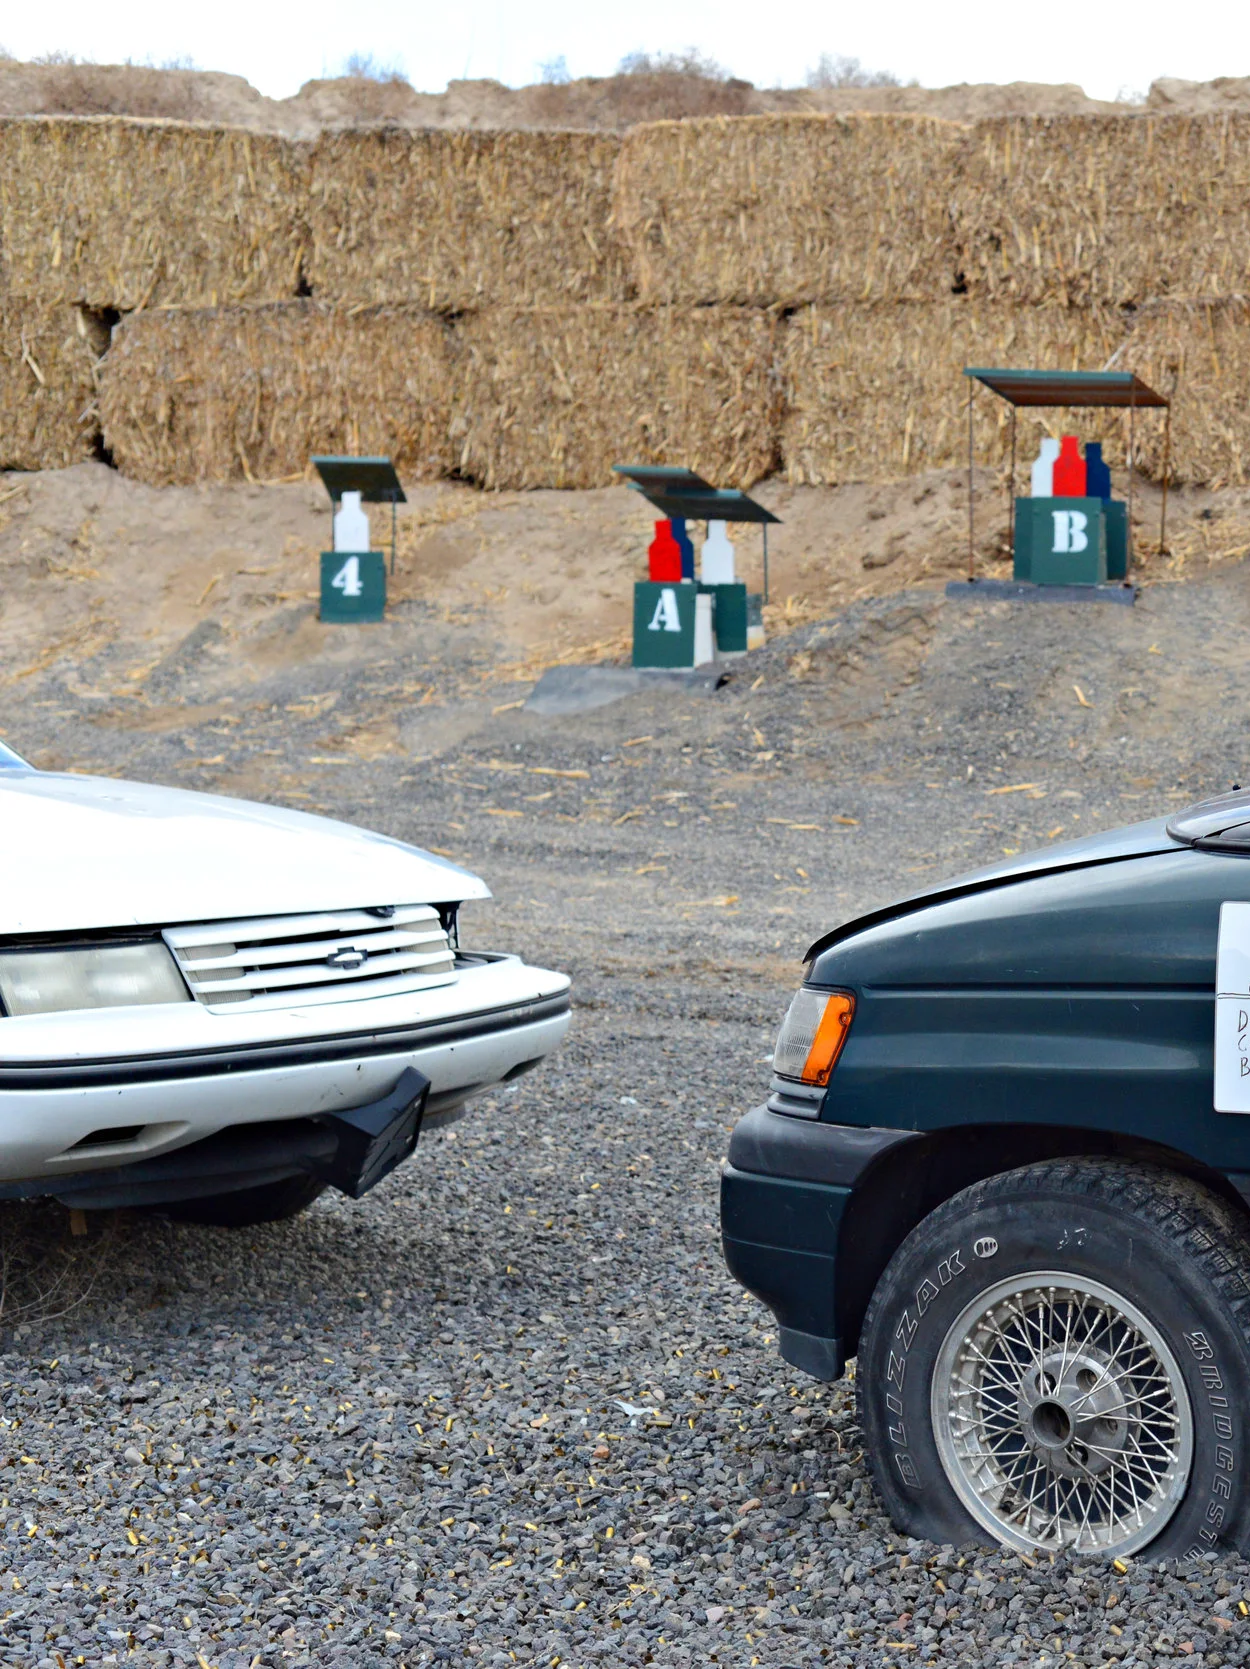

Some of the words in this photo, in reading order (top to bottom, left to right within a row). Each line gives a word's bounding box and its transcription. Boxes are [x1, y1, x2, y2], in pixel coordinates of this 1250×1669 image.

[1051, 510, 1088, 553] B
[331, 556, 363, 596] 4
[648, 588, 681, 632] A
[886, 1250, 966, 1490] BLIZZAK
